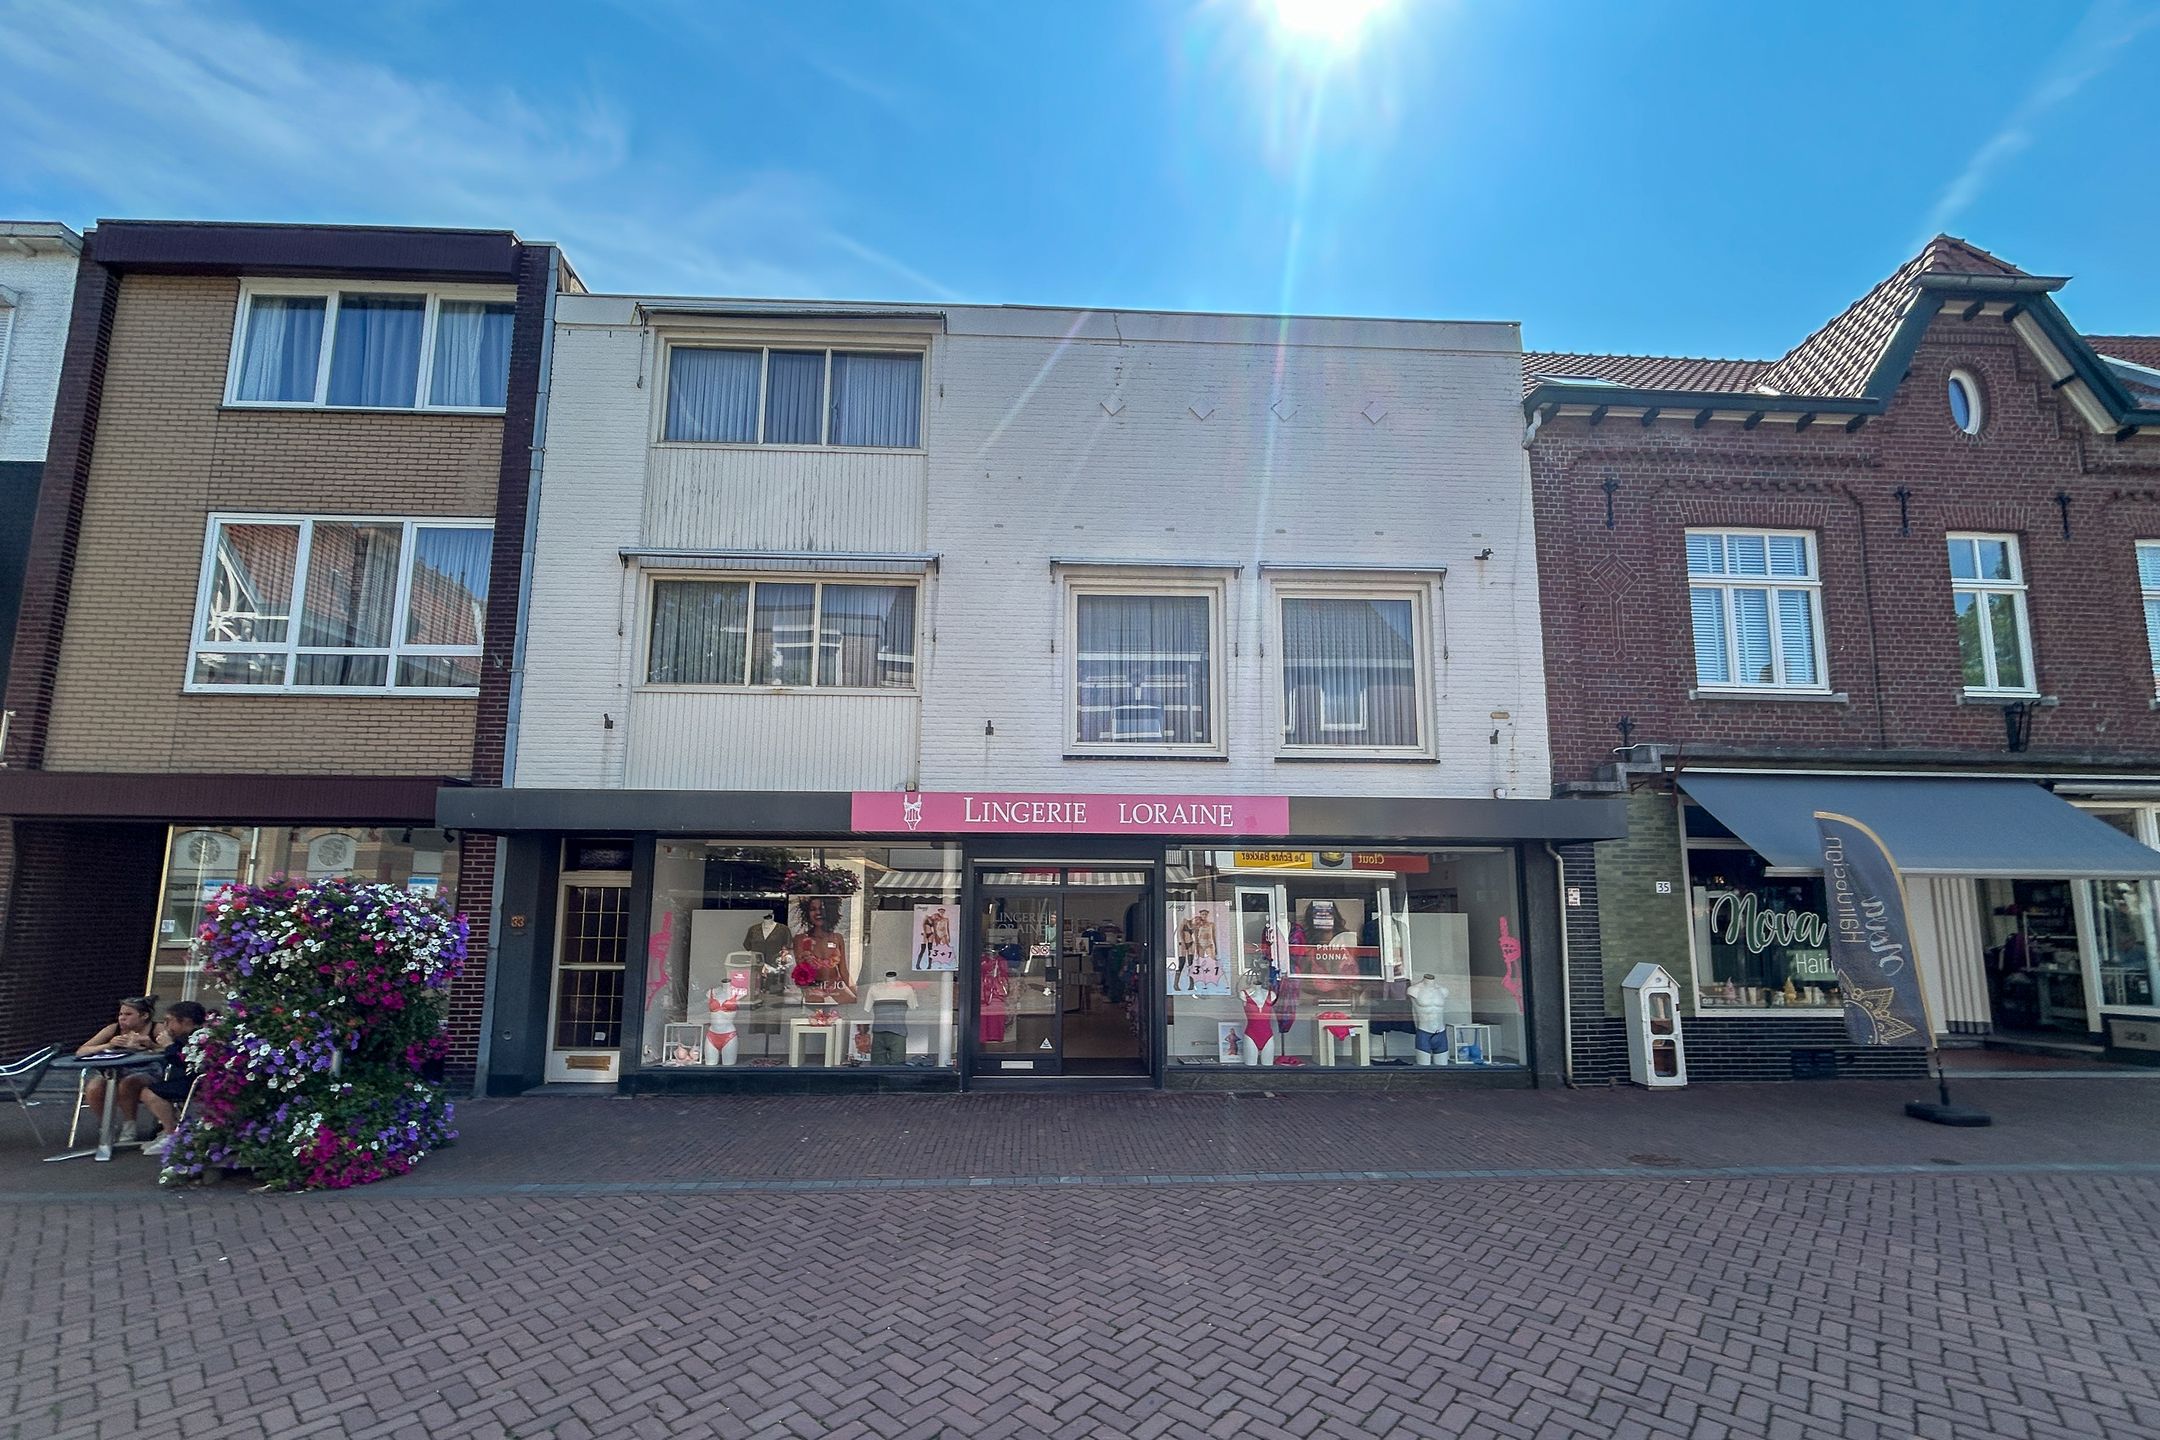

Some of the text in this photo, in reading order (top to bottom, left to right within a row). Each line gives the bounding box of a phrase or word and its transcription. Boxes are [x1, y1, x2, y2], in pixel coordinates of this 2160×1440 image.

[963, 797, 1234, 827] LINGERIE LORAINE
[1657, 883, 1670, 892] 35
[511, 915, 525, 927] 33
[1711, 892, 1828, 954] Nova
[1192, 965, 1201, 975] 3
